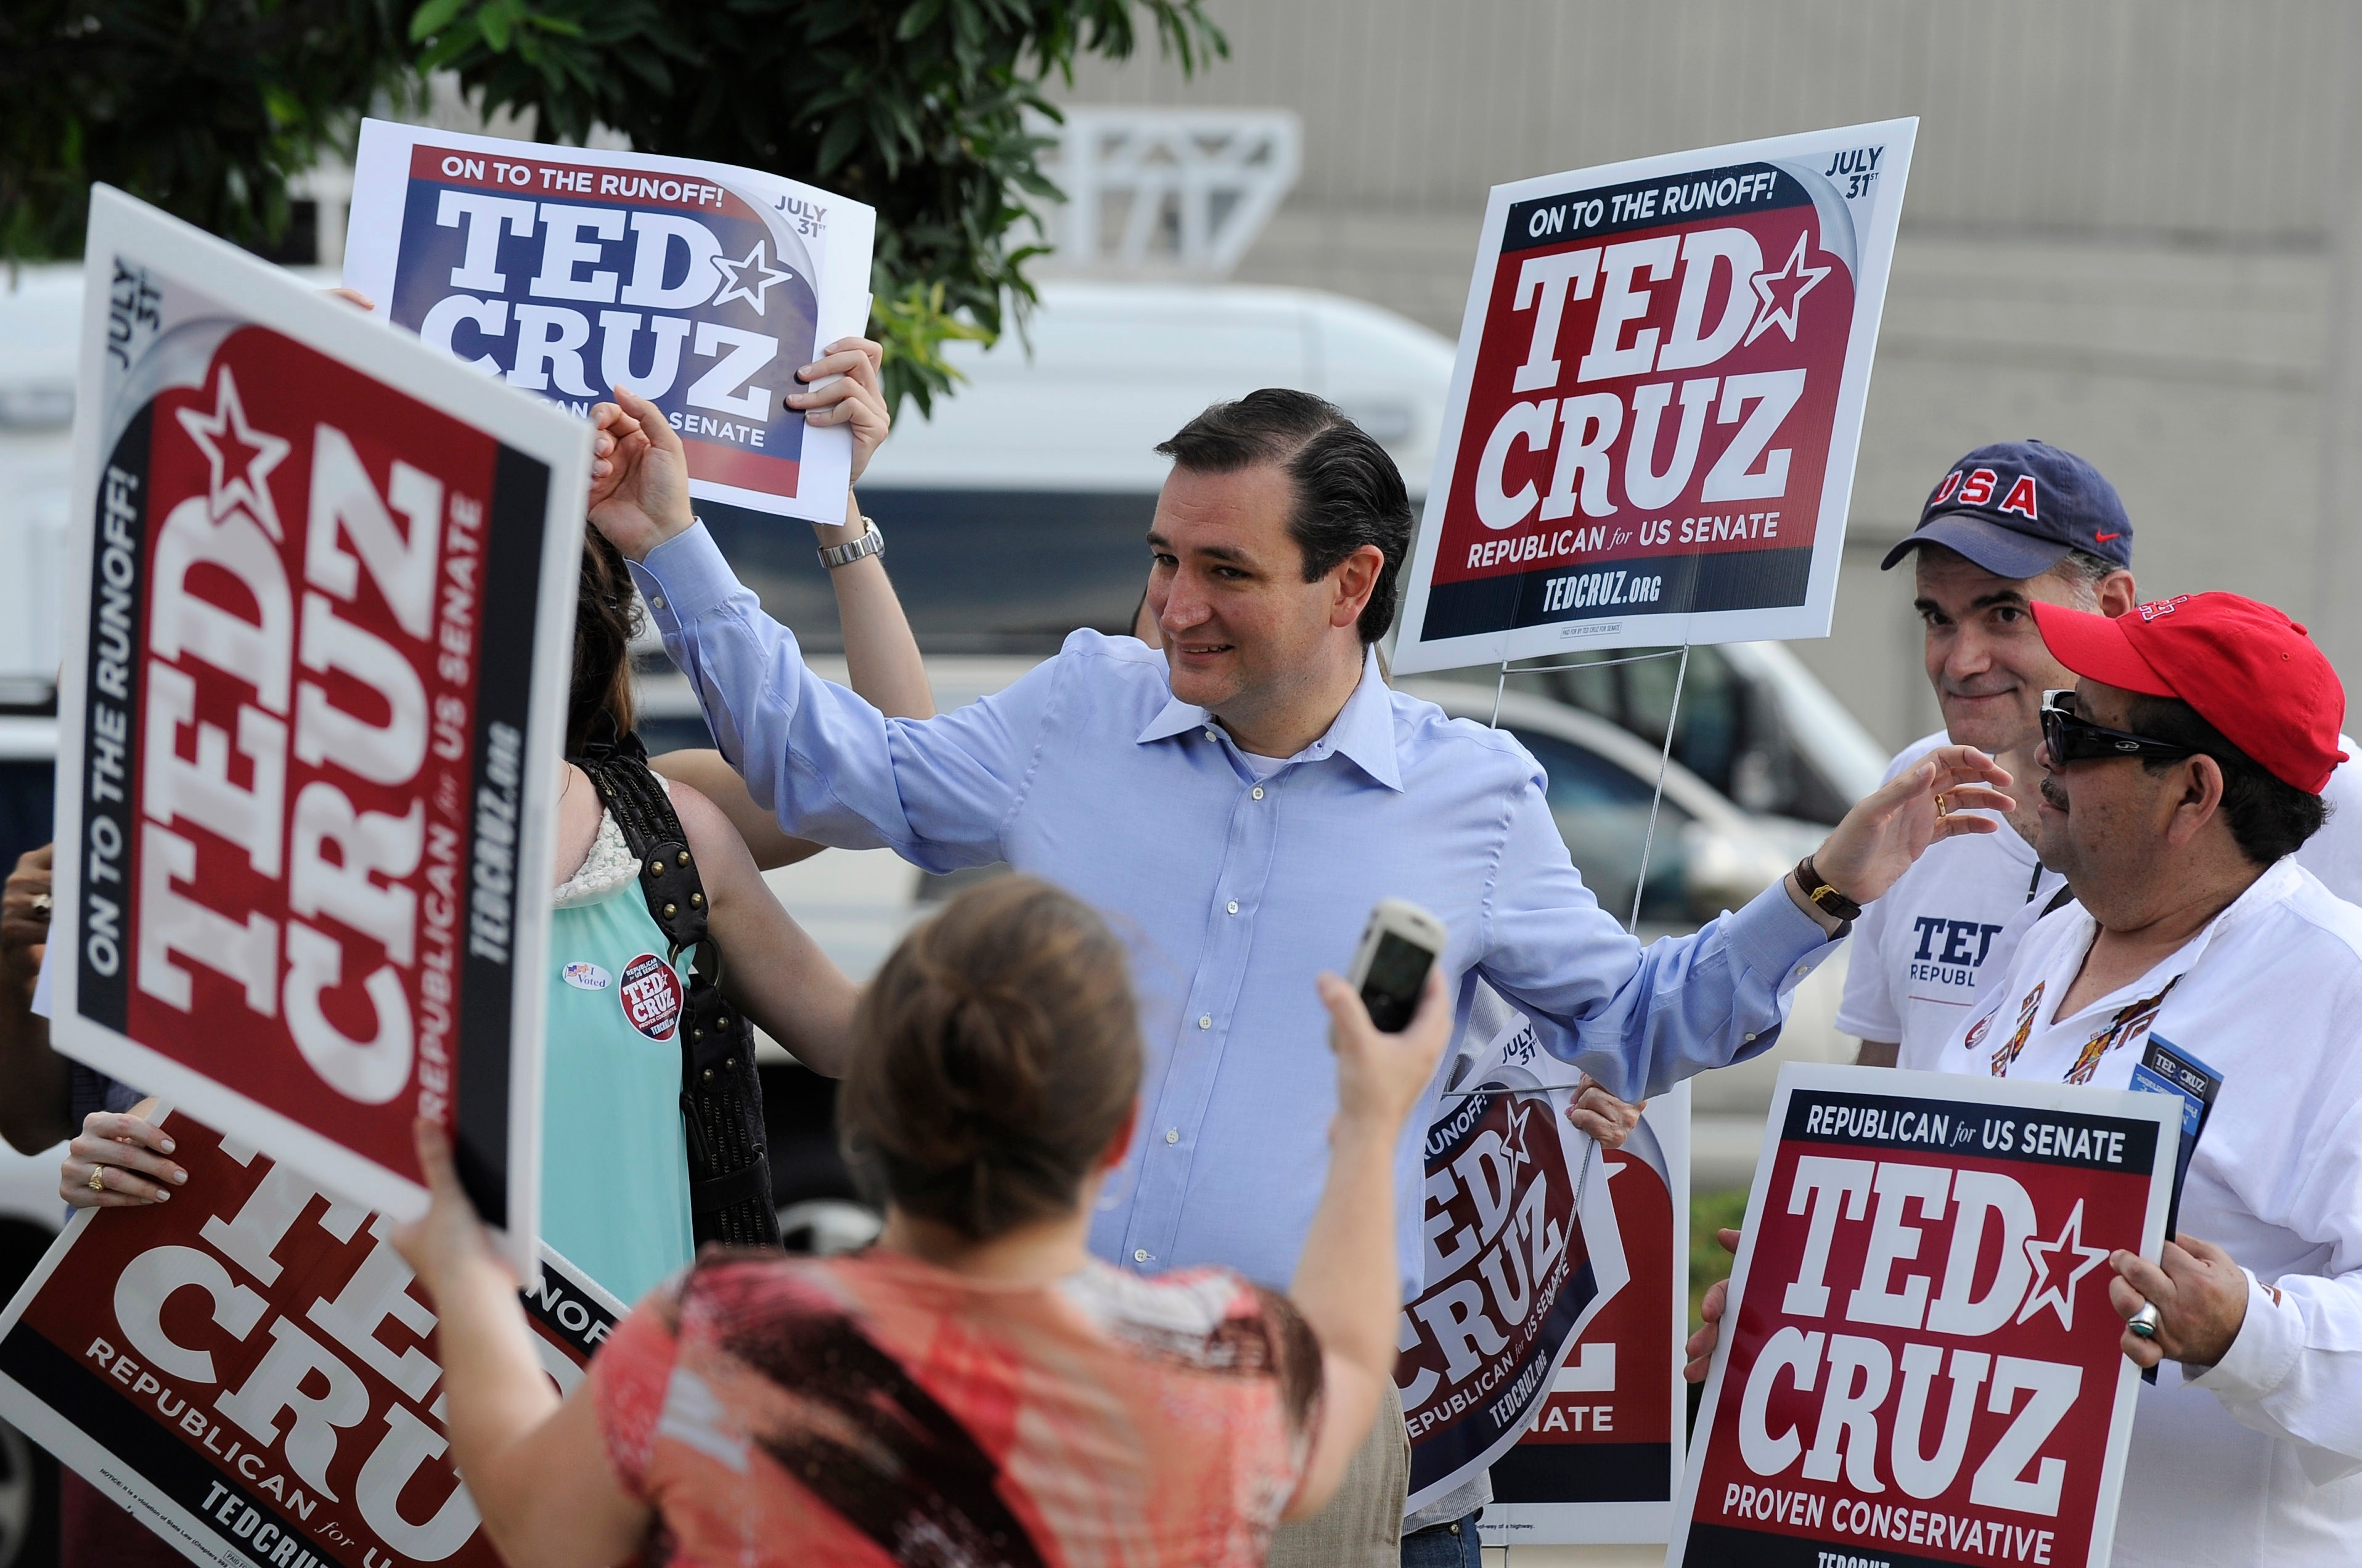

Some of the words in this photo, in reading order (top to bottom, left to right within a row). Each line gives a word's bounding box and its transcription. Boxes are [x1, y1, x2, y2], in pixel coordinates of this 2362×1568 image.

[441, 157, 485, 182] ON
[493, 162, 532, 186] TO
[540, 169, 593, 193] THE
[600, 176, 724, 208] RUNOFF!
[1825, 146, 1884, 176] JULY
[774, 195, 827, 222] JULY
[1529, 208, 1565, 237] ON
[1573, 199, 1603, 231] TO
[1611, 190, 1656, 224] THE
[1662, 172, 1778, 217] RUNOFF!
[436, 190, 723, 309] TED
[108, 253, 135, 370] JULY
[1512, 227, 1764, 393] TED
[420, 294, 778, 422] CRUZ
[669, 412, 766, 447] SENATE
[1475, 368, 1807, 529] CRUZ
[1929, 467, 2039, 521] USA
[1467, 525, 1605, 569] REPUBLICAN
[1607, 526, 1632, 552] for
[1639, 520, 1672, 547] US
[1678, 512, 1780, 545] SENATE
[96, 466, 139, 698] RUNOFF!
[438, 491, 483, 687] SENATE
[1543, 571, 1662, 612] TEDCRUZ.ORG
[92, 712, 125, 802] THE
[138, 495, 294, 1018] TED
[433, 693, 467, 762] US
[282, 422, 444, 1105] CRUZ
[91, 815, 122, 886] TO
[88, 893, 121, 977] ON
[626, 958, 657, 976] REPUBLICAN
[418, 823, 459, 1123] REPUBLICAN
[578, 974, 606, 987] Voted
[589, 967, 594, 975] I
[623, 973, 663, 1005] TED
[632, 987, 676, 1023] CRUZ
[1911, 964, 1975, 987] REPUBL
[639, 1018, 656, 1029] PROVEN
[1502, 1023, 1533, 1064] JULY
[2180, 1069, 2205, 1092] CRUZ
[1807, 1104, 1950, 1145] REPUBLICAN
[1950, 1122, 1976, 1148] for
[1982, 1119, 2014, 1152] US
[2021, 1124, 2127, 1164] SENATE
[1424, 1129, 1515, 1289] ED
[199, 1133, 586, 1419] TE
[1781, 1156, 2038, 1336] TED
[1405, 1351, 1514, 1438] EPUBLICAN
[1514, 1340, 1525, 1362] for
[1523, 1315, 1537, 1342] US
[1536, 1257, 1570, 1321] SENATE
[114, 1246, 483, 1562] CRU
[1489, 1349, 1548, 1429] TEDCRUZ.ORG
[1527, 1406, 1613, 1432] ATE
[1739, 1326, 2083, 1517] CRUZ
[86, 1336, 317, 1521] REPUBLICAN
[314, 1521, 354, 1548] for
[137, 1498, 160, 1516] violation
[166, 1519, 181, 1532] State
[1723, 1482, 1826, 1529] PROVEN
[1832, 1498, 2054, 1566] CONSERVATIVE
[226, 1553, 239, 1565] PAID
